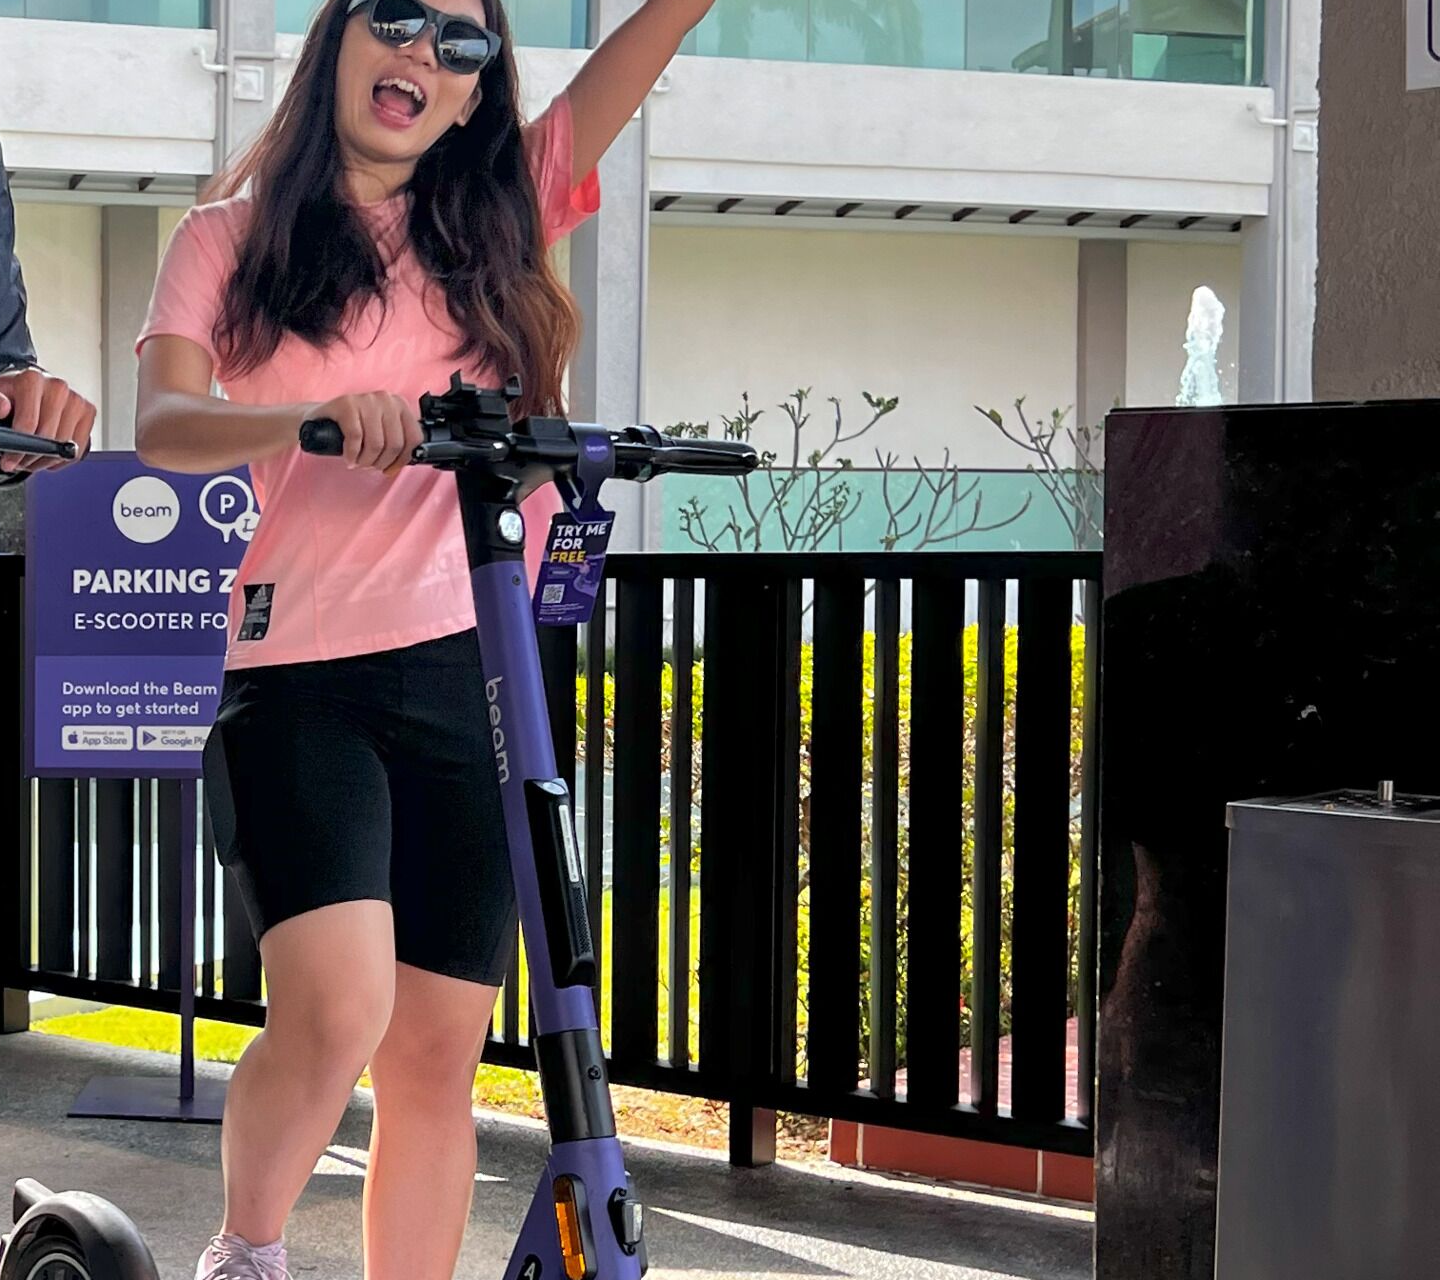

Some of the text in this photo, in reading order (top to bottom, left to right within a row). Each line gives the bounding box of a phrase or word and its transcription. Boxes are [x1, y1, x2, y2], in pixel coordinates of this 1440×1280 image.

[120, 503, 172, 518] beam
[220, 494, 236, 514] P
[556, 523, 607, 537] TRY ME
[552, 538, 584, 551] FOR
[549, 550, 587, 563] FREE
[73, 569, 239, 594] PARKING Z
[74, 612, 194, 630] E-SCOOTER
[200, 612, 229, 630] FO
[62, 681, 218, 696] Download the Beam
[62, 701, 200, 718] app to get started
[486, 676, 510, 785] beam
[82, 735, 128, 747] App Store
[160, 736, 193, 748] Google
